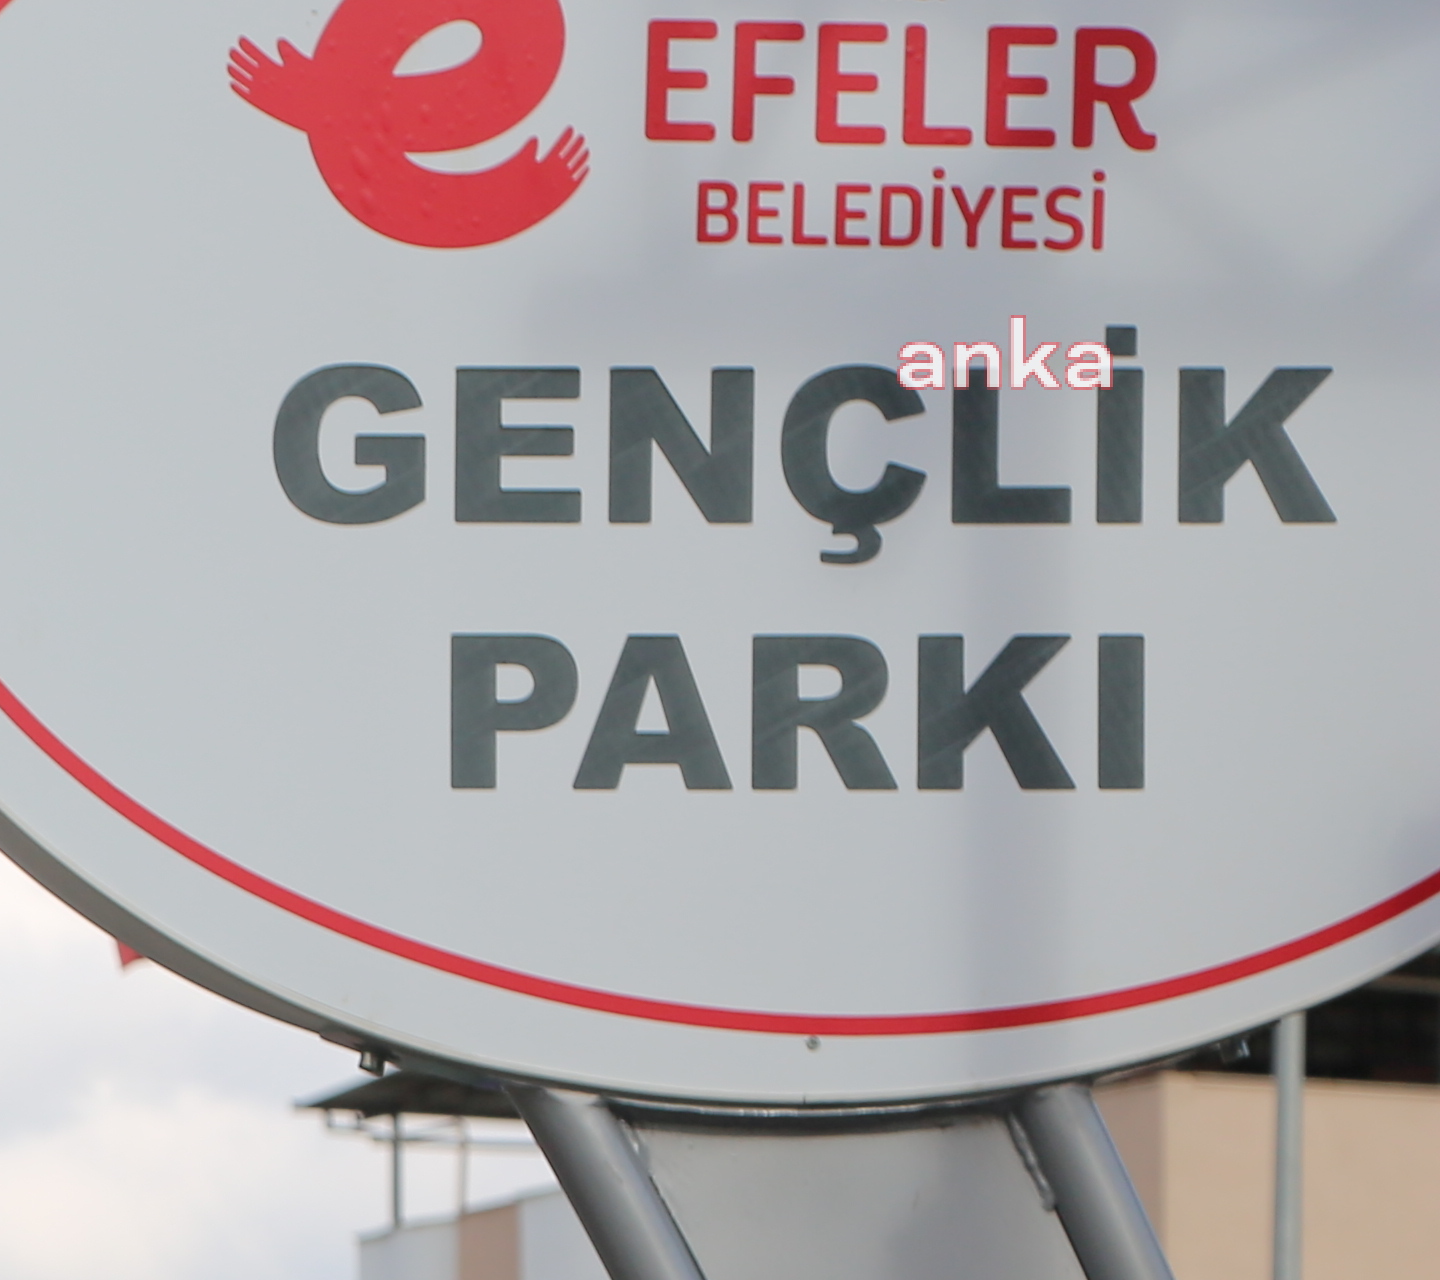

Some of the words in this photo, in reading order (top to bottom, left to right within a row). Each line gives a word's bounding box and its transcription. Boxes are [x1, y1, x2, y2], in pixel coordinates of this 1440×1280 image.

[645, 19, 1157, 151] EFELER
[696, 167, 1106, 251] BELEDİYESİ
[272, 326, 1337, 565] GENÇLİK
[450, 634, 1145, 791] PARKI
